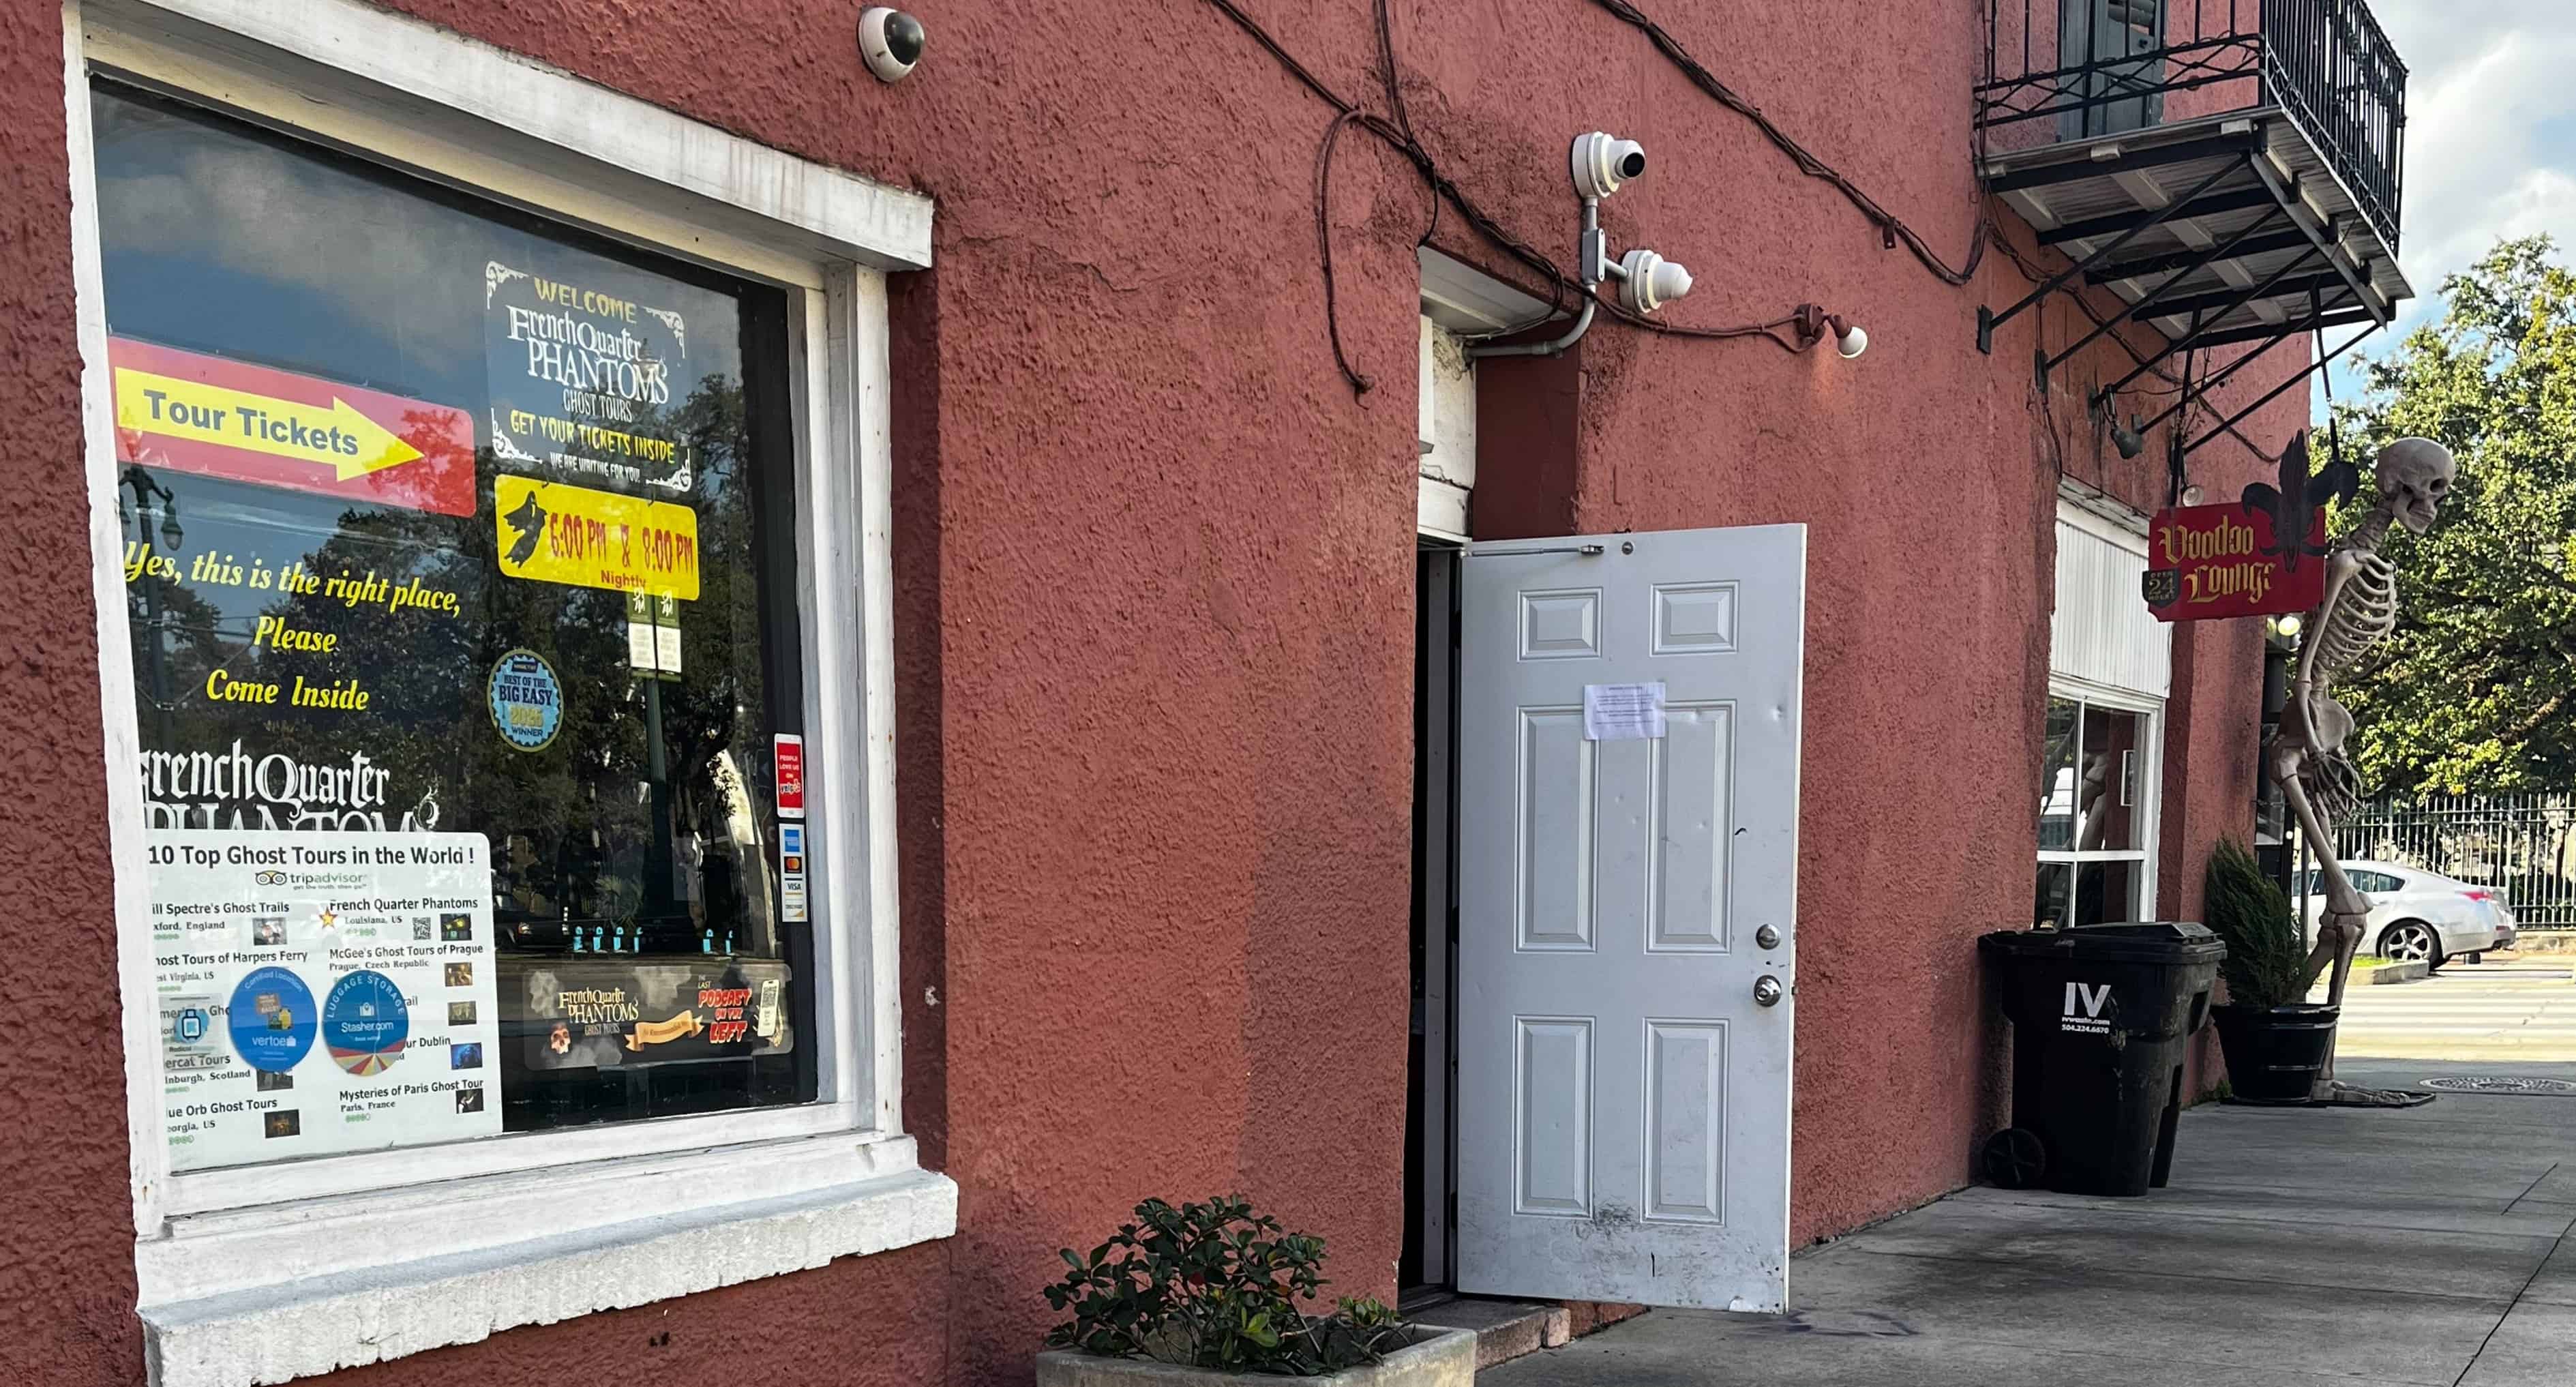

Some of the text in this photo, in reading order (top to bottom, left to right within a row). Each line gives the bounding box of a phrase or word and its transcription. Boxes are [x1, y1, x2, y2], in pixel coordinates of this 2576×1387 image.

[534, 277, 637, 324] WELCOME
[527, 338, 669, 404] PHANTOMS
[563, 389, 633, 423] GHOST TOURS
[143, 389, 359, 456] Tour Tickets
[510, 410, 675, 464] GET YOUR TICKETS INSIDE
[550, 451, 640, 483] WE ARE WAITING FOR YOU!
[550, 512, 694, 577] 6:00 PM & 8:00 PM
[2158, 514, 2254, 564] Voodoo
[124, 541, 461, 618] Yes, this is the right place,
[601, 570, 646, 588] Nightly
[2149, 578, 2174, 594] 24
[2184, 563, 2277, 603] Lounge
[254, 615, 338, 654] Please
[207, 669, 370, 711] Come Inside
[505, 674, 546, 688] BEST OF THE
[499, 685, 552, 706] BIG EASY
[511, 727, 543, 736] WINNER
[148, 845, 175, 864] 10
[181, 846, 220, 869] Top
[226, 846, 287, 865] Ghost
[291, 846, 346, 864] Tours
[352, 846, 370, 864] in
[376, 846, 405, 864] the
[410, 846, 463, 864] World
[290, 873, 363, 884] tripadvisor
[151, 901, 289, 916] ill Spectre's Ghost Trails
[329, 897, 479, 912] French Quarter Phantoms
[153, 921, 225, 931] xford, England
[182, 954, 215, 966] Tours
[218, 952, 229, 963] of
[233, 952, 276, 964] Harpers
[280, 951, 308, 963] Ferry
[329, 944, 483, 959] McGee's Ghost Tours of Prague
[365, 961, 390, 969] Czech
[393, 959, 429, 968] Republic
[698, 981, 711, 989] LAST
[327, 976, 363, 1018] LUGGAGE
[367, 976, 404, 1015] STORAGE
[698, 988, 752, 1009] PODCAST
[2064, 982, 2111, 1017] IV
[567, 1002, 639, 1024] PHANTOMS
[341, 1021, 395, 1033] Stasher.com
[710, 1021, 748, 1043] LEFT
[252, 1035, 286, 1046] vertoe
[419, 1036, 451, 1047] Dublin
[164, 1055, 230, 1069] ercat Tours
[209, 1069, 251, 1080] Scotland
[340, 1079, 483, 1102] Mysteries of Paris Ghost Tour
[186, 1105, 207, 1116] Orb
[211, 1101, 243, 1114] Ghost
[246, 1099, 278, 1111] Tours
[368, 1101, 395, 1109] France
